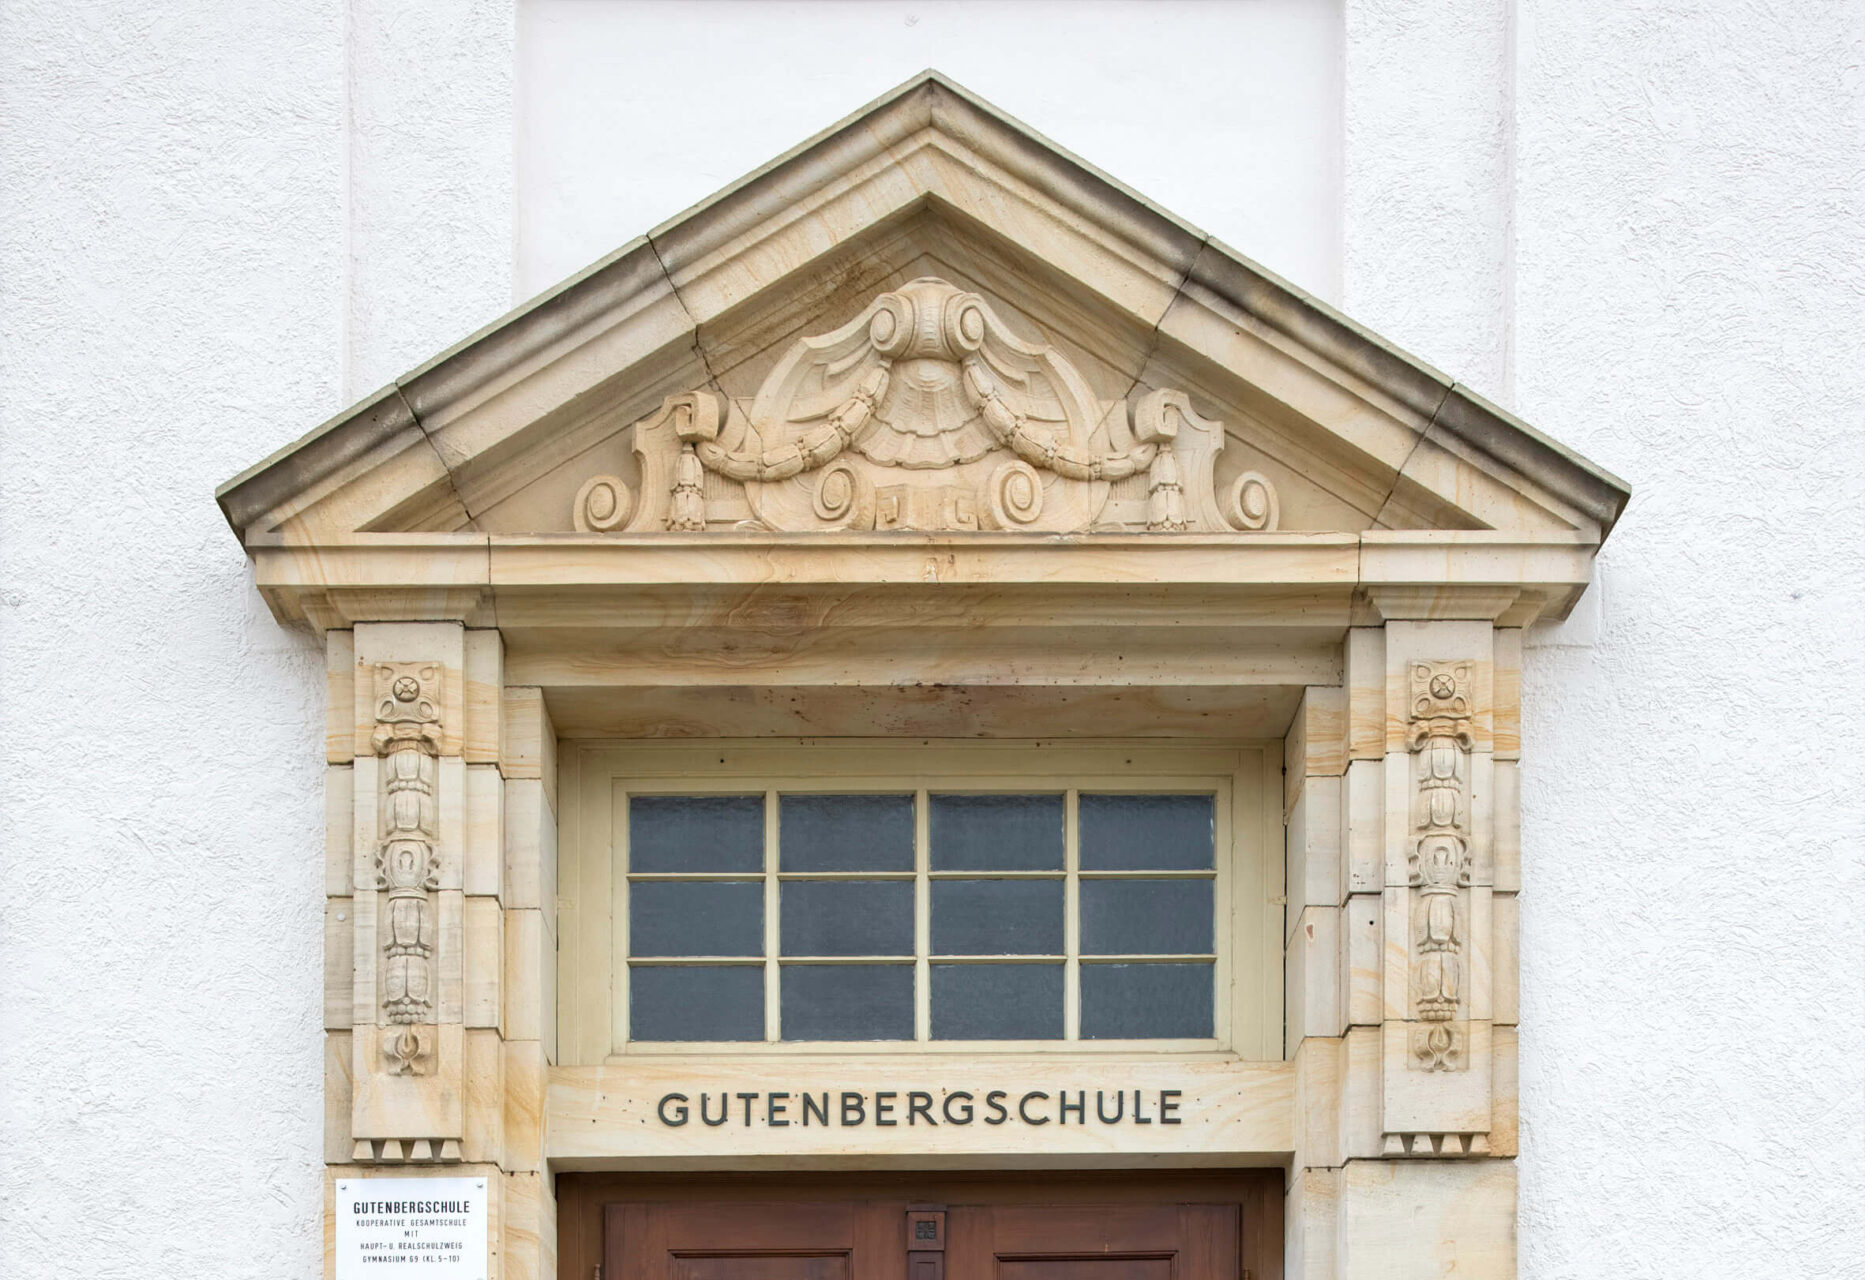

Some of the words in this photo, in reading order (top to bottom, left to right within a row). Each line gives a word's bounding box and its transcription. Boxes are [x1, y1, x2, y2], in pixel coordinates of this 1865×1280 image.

[657, 1090, 1182, 1128] GUTENBERGSCHULE
[353, 1201, 470, 1214] GUTENBERGSCHULE
[356, 1219, 406, 1227] KOOPERATIVE
[404, 1230, 419, 1238] MIT
[360, 1242, 387, 1250] HAUPT-
[398, 1242, 463, 1250] REALSCHULZWEIG
